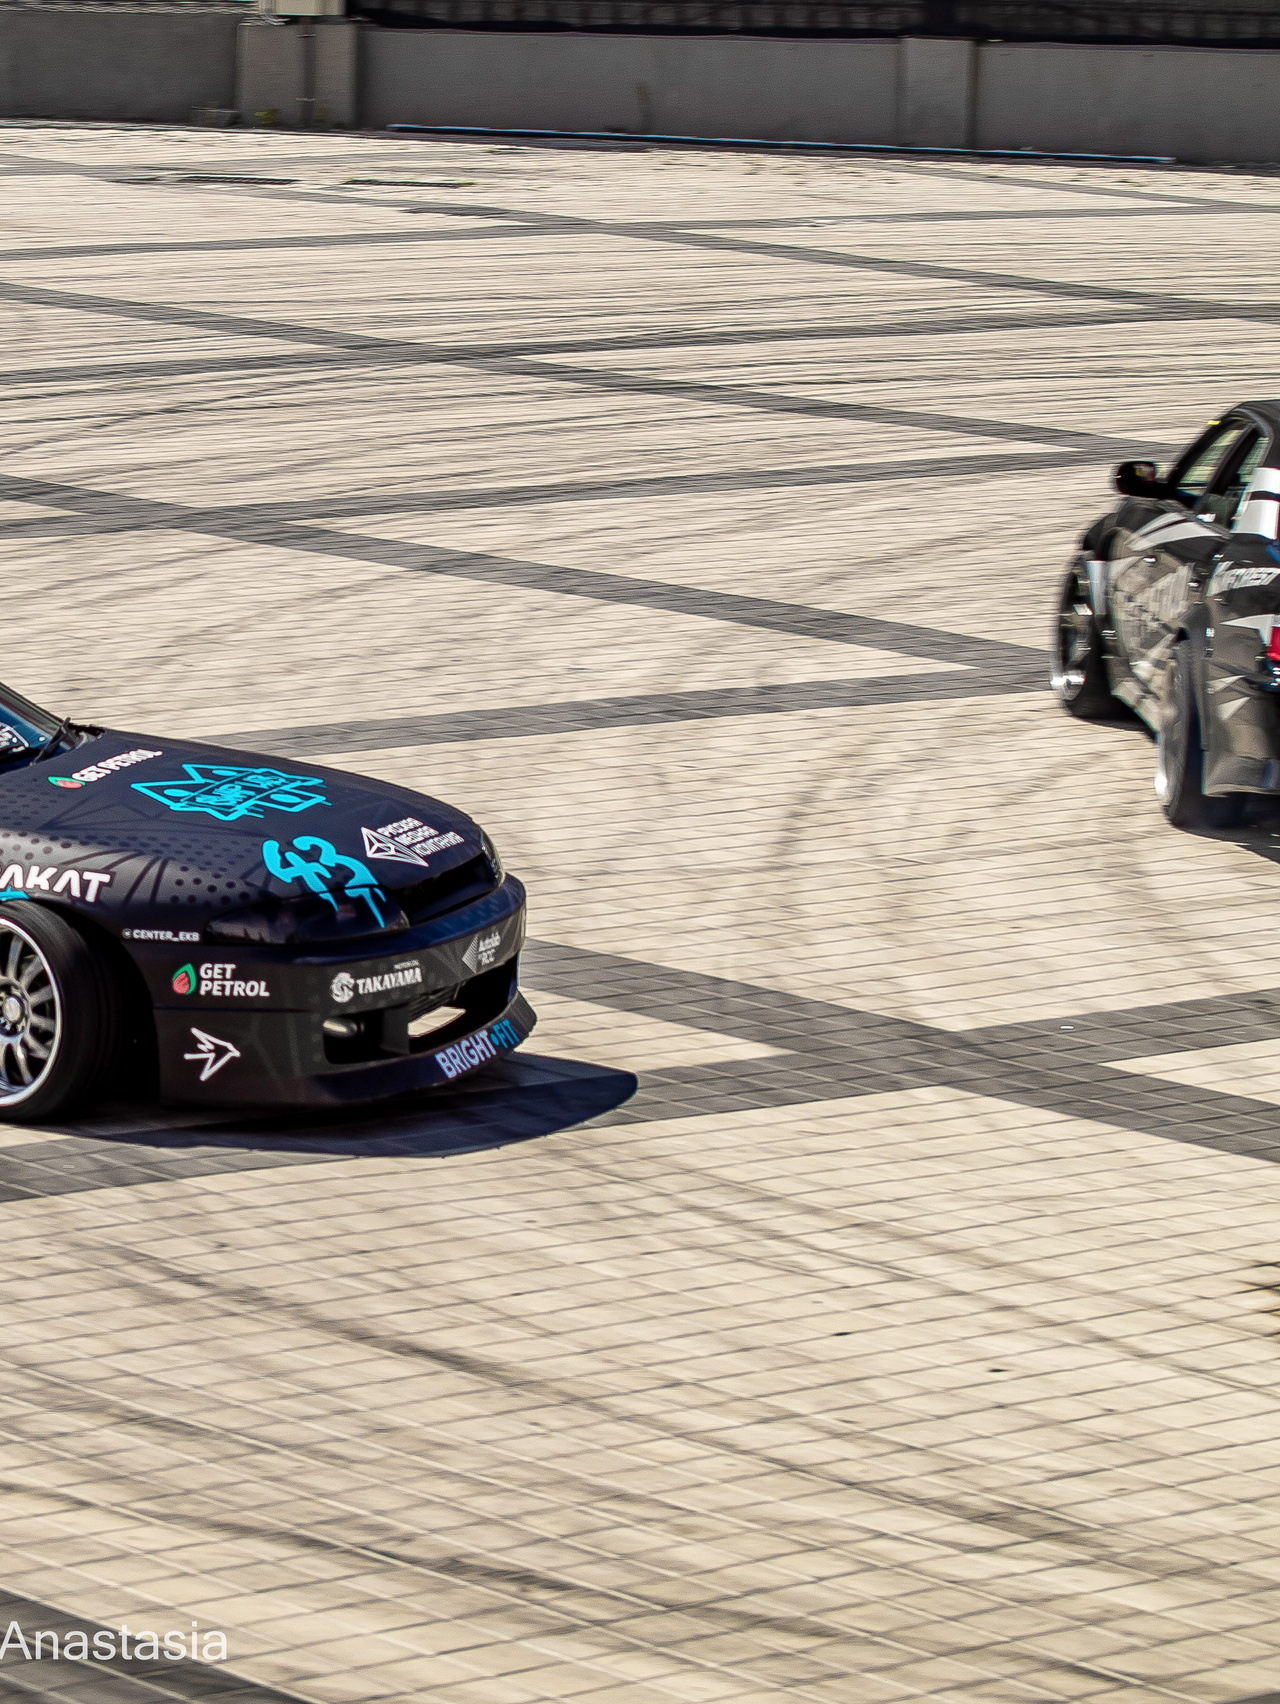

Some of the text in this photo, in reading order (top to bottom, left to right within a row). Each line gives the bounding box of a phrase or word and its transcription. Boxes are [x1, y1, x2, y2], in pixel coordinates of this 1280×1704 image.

[200, 963, 236, 979] GET
[356, 967, 422, 995] TAKAYAMA
[200, 980, 270, 997] PETROL
[435, 1029, 497, 1078] BRIGHT
